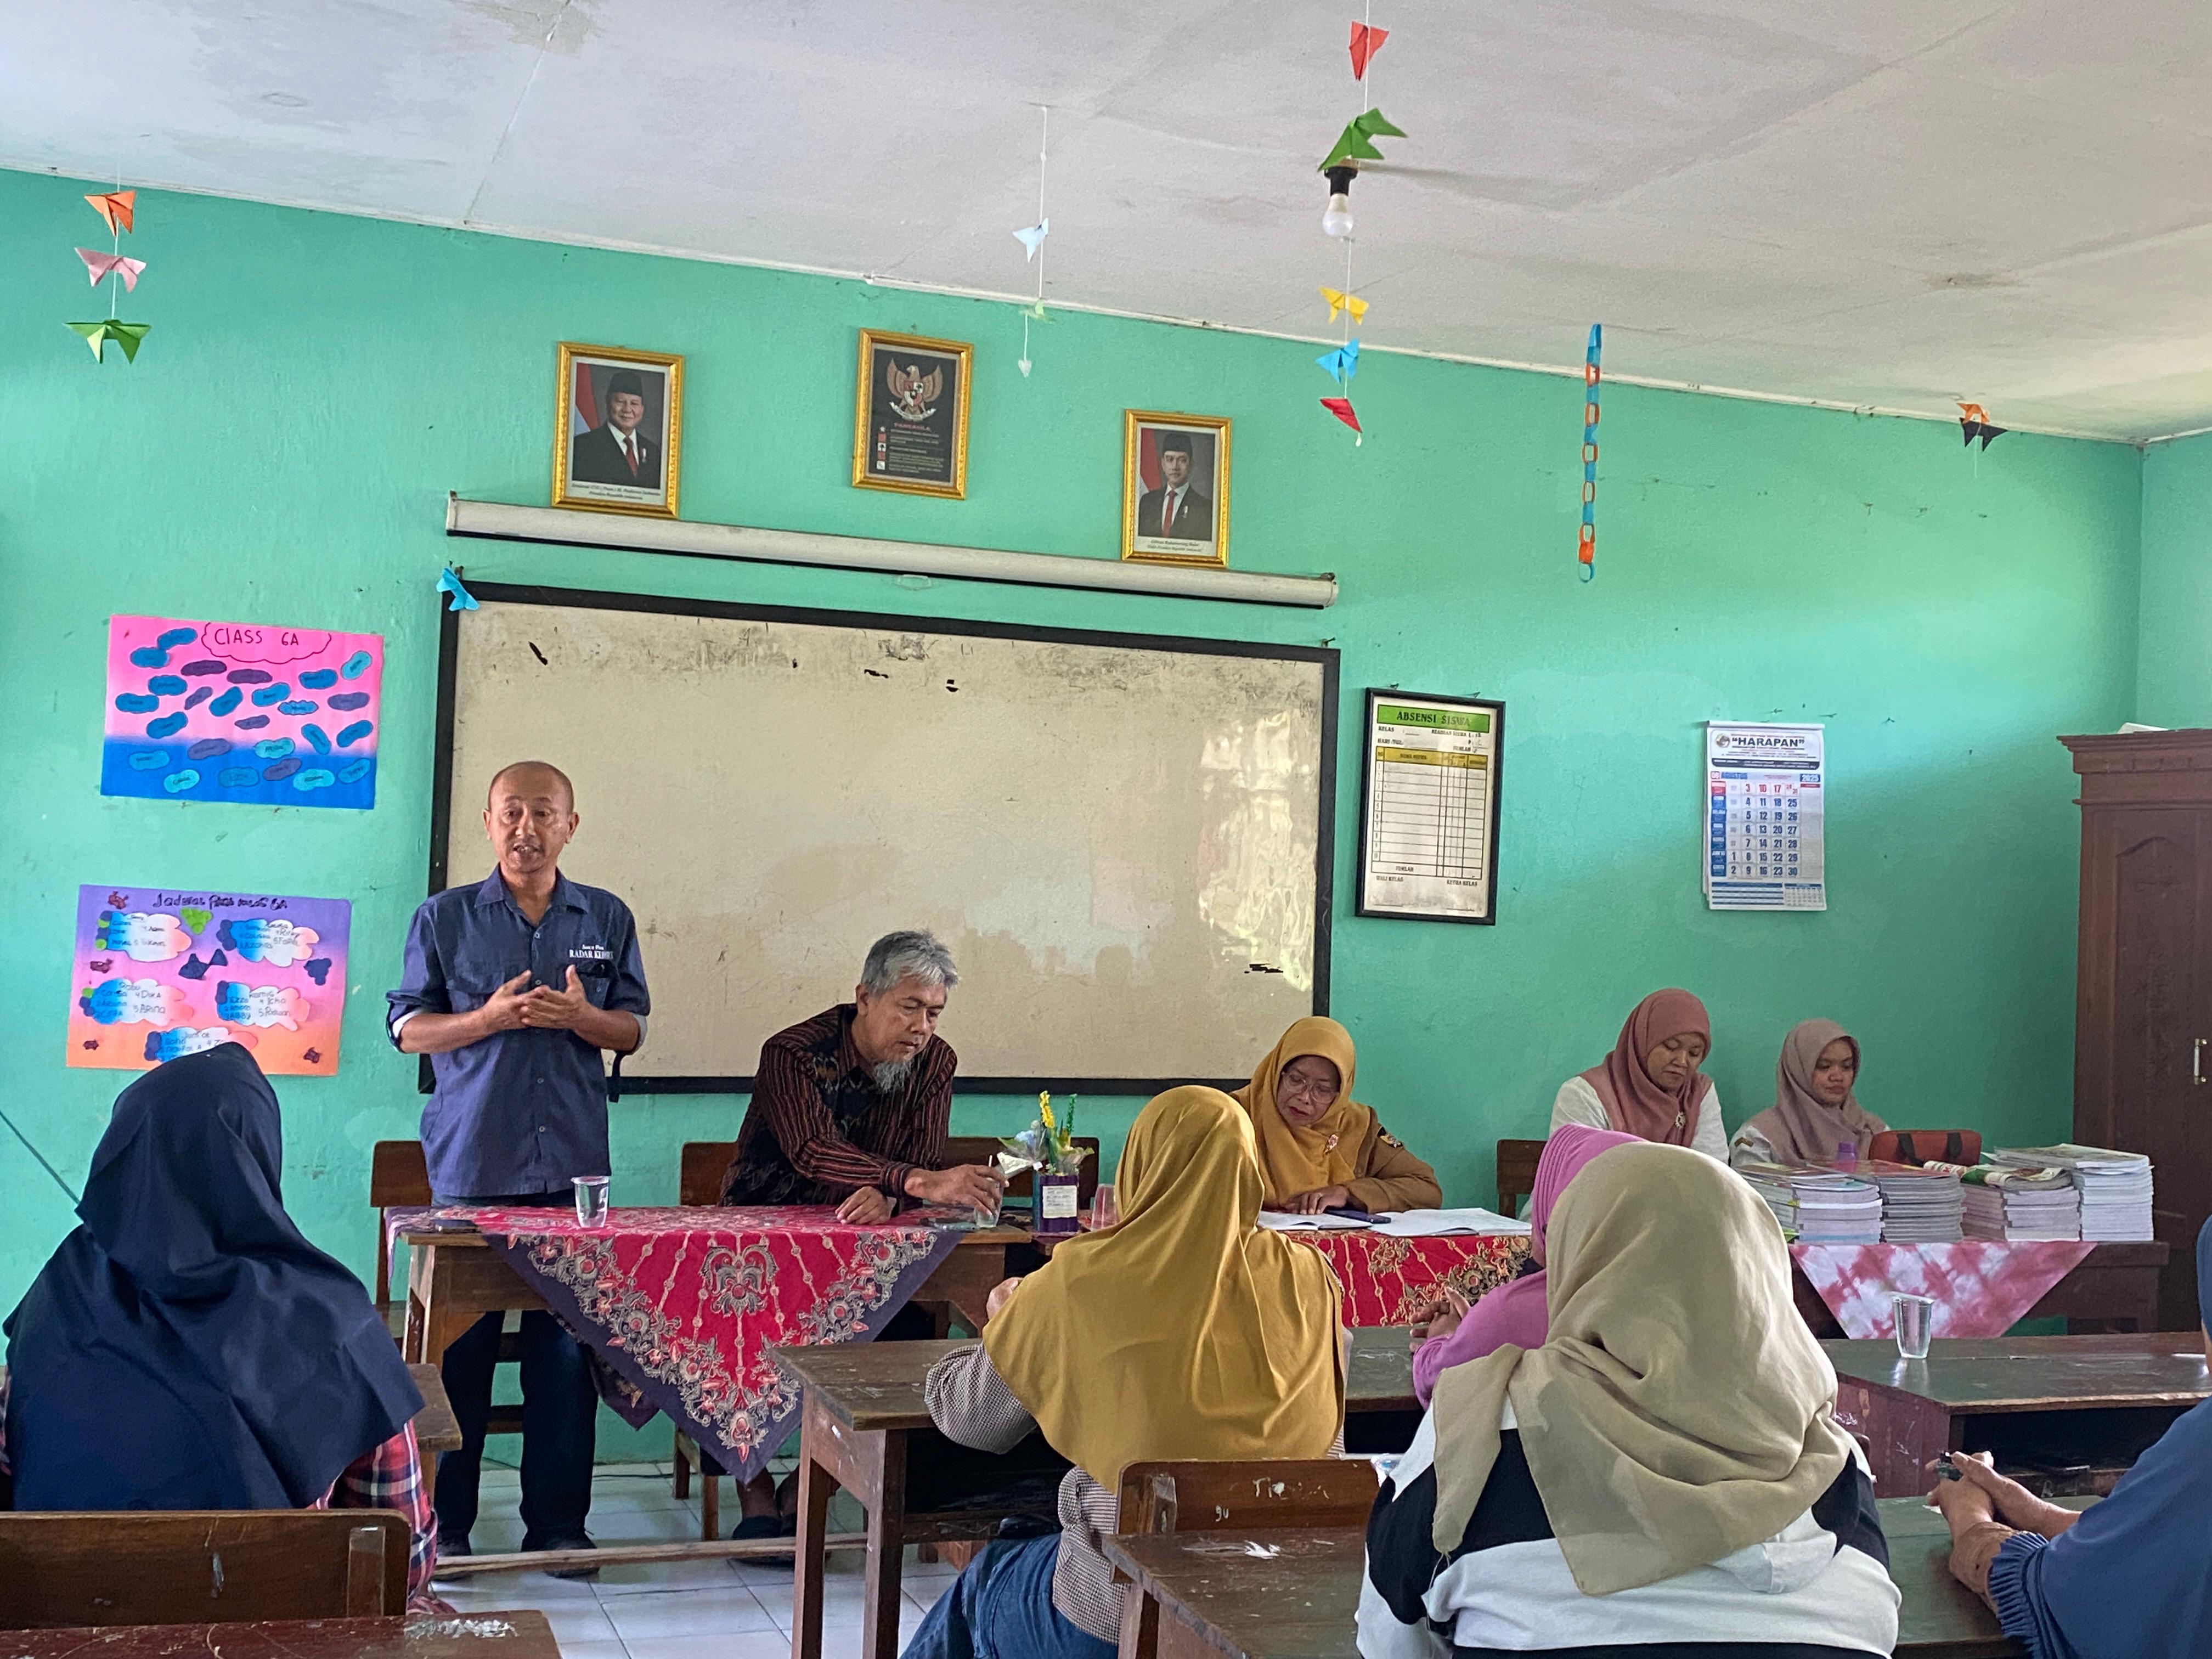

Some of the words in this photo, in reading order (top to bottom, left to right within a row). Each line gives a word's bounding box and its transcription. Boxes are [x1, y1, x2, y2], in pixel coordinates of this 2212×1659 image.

[281, 632, 299, 646] 6A
[1397, 711, 1436, 723] ABSENSI
[1441, 715, 1471, 726] SISWA
[1746, 784, 1750, 792] 3
[1759, 785, 1767, 793] 10
[1774, 785, 1781, 793] 17
[1746, 798, 1751, 806] 4
[1760, 798, 1767, 806] 11
[1774, 798, 1782, 806] 18
[1787, 798, 1797, 808] 25
[1746, 811, 1751, 820] 5
[1759, 811, 1768, 820] 12
[1774, 812, 1782, 821] 19
[1788, 812, 1798, 821] 26
[1746, 825, 1751, 833] 6
[1759, 825, 1767, 834] 13
[1773, 825, 1782, 834] 20
[1787, 826, 1797, 834] 27
[1746, 838, 1751, 848] 7
[1759, 839, 1768, 848] 14
[1774, 839, 1782, 848] 21
[1788, 839, 1798, 848] 28
[1732, 852, 1736, 861] 1
[1746, 853, 1751, 861] 8
[1759, 853, 1768, 861] 15
[1773, 853, 1782, 862] 22
[1788, 853, 1798, 862] 29
[1731, 866, 1736, 874] 2
[1746, 866, 1751, 874] 9
[1759, 867, 1768, 875] 16
[1773, 867, 1782, 876] 23
[1788, 867, 1798, 876] 30
[569, 949, 594, 958] RADAR
